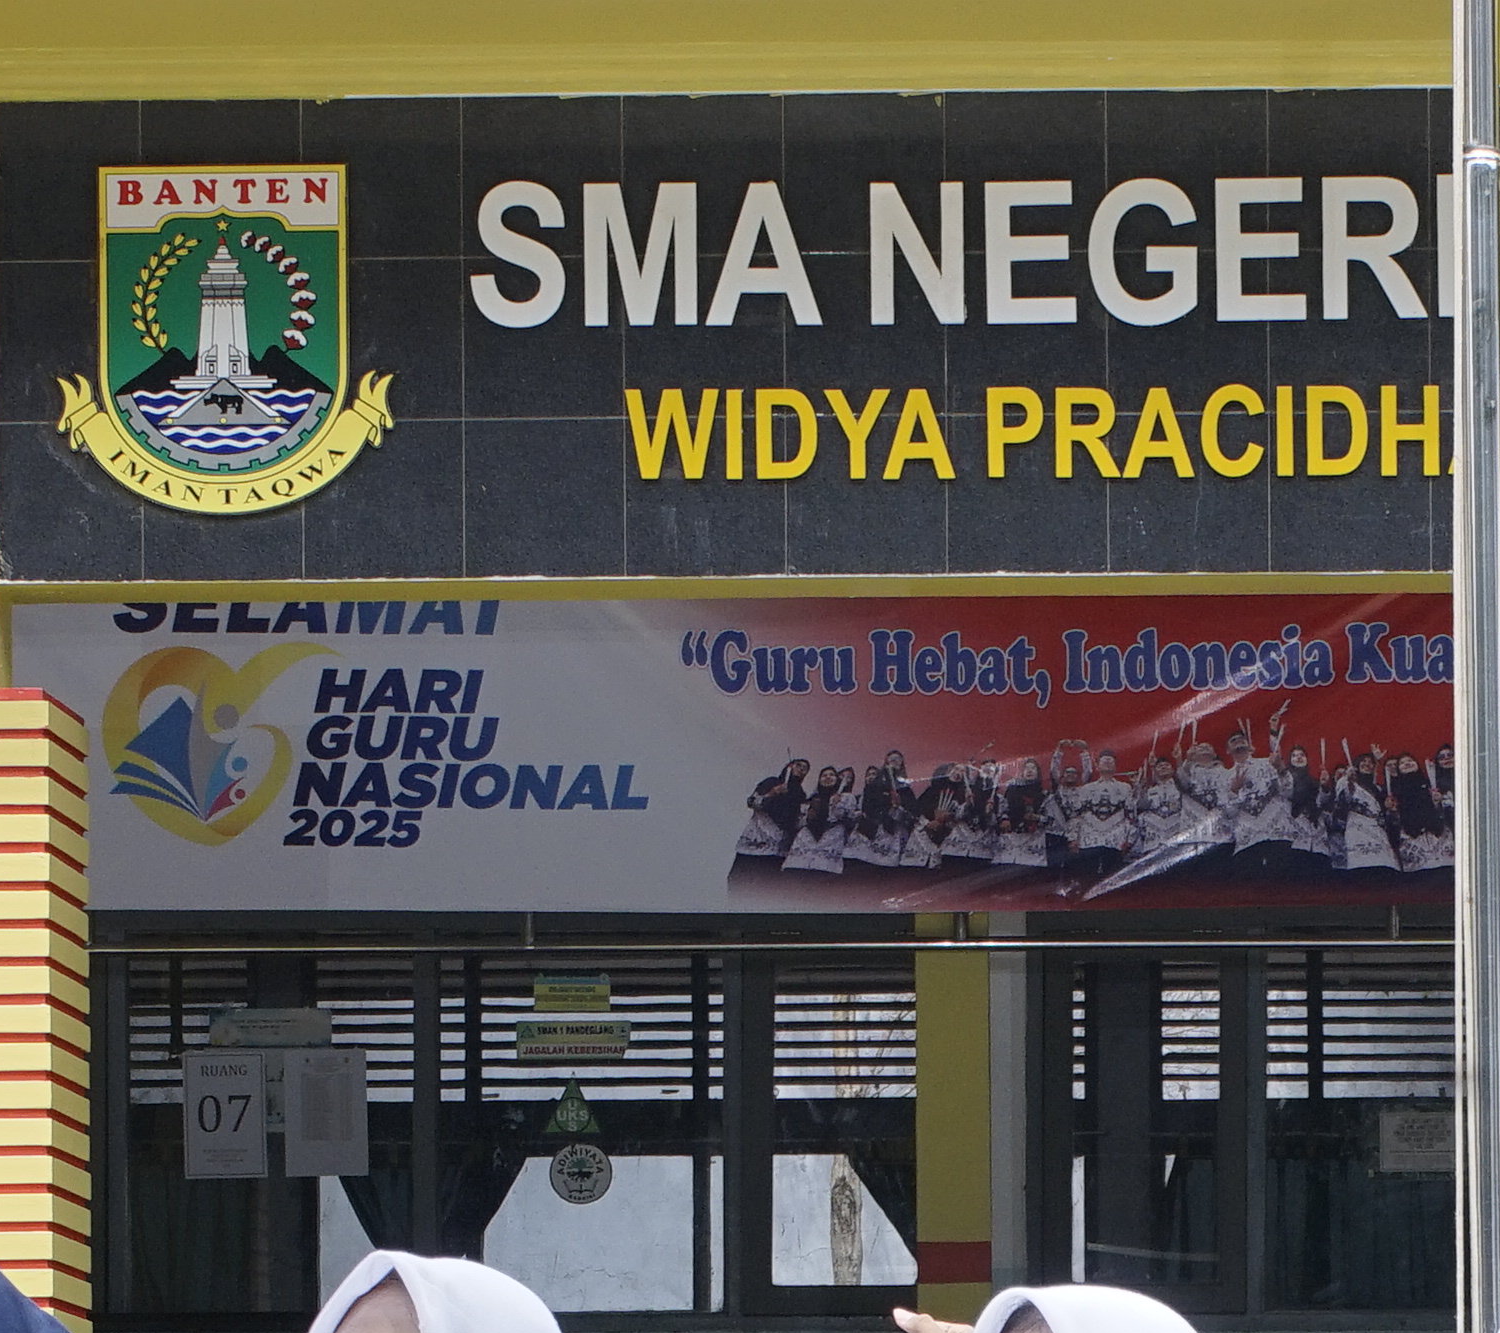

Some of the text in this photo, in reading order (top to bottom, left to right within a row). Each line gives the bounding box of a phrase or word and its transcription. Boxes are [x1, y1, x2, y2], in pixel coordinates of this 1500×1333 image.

[117, 178, 328, 206] BANTEN
[471, 181, 822, 328] SMA
[871, 174, 1454, 325] NEGERI
[626, 388, 956, 481] WIDYA
[869, 628, 1052, 709] Hebat,
[1062, 624, 1336, 694] Indonesia
[313, 669, 484, 713] HARI
[306, 715, 499, 761] GURU
[291, 763, 649, 811] NASIONAL
[282, 809, 422, 847] 2025
[200, 1063, 249, 1078] RUANG
[197, 1094, 253, 1134] 07
